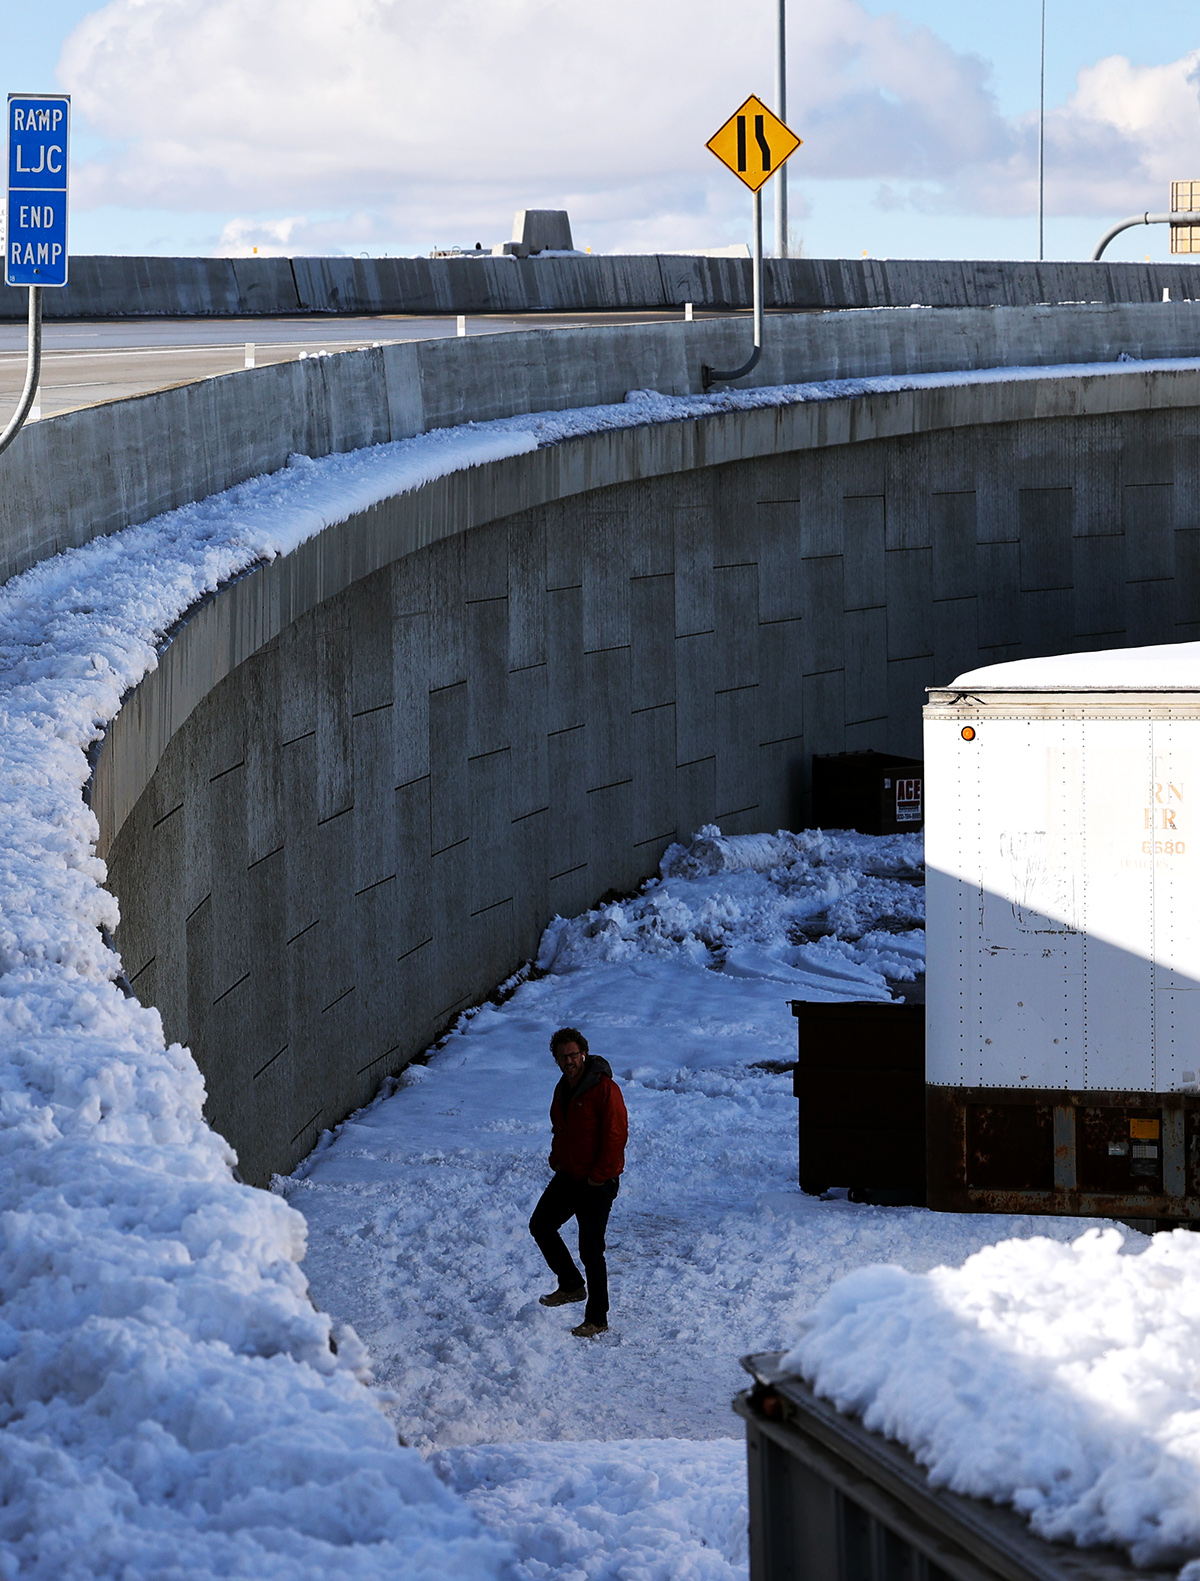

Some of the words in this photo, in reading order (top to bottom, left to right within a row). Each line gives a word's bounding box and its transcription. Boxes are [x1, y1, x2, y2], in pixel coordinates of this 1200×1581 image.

[14, 108, 63, 131] RAMP
[16, 145, 62, 173] LJC
[20, 206, 54, 228] END
[11, 242, 62, 265] RAMP
[897, 780, 921, 800] ACE
